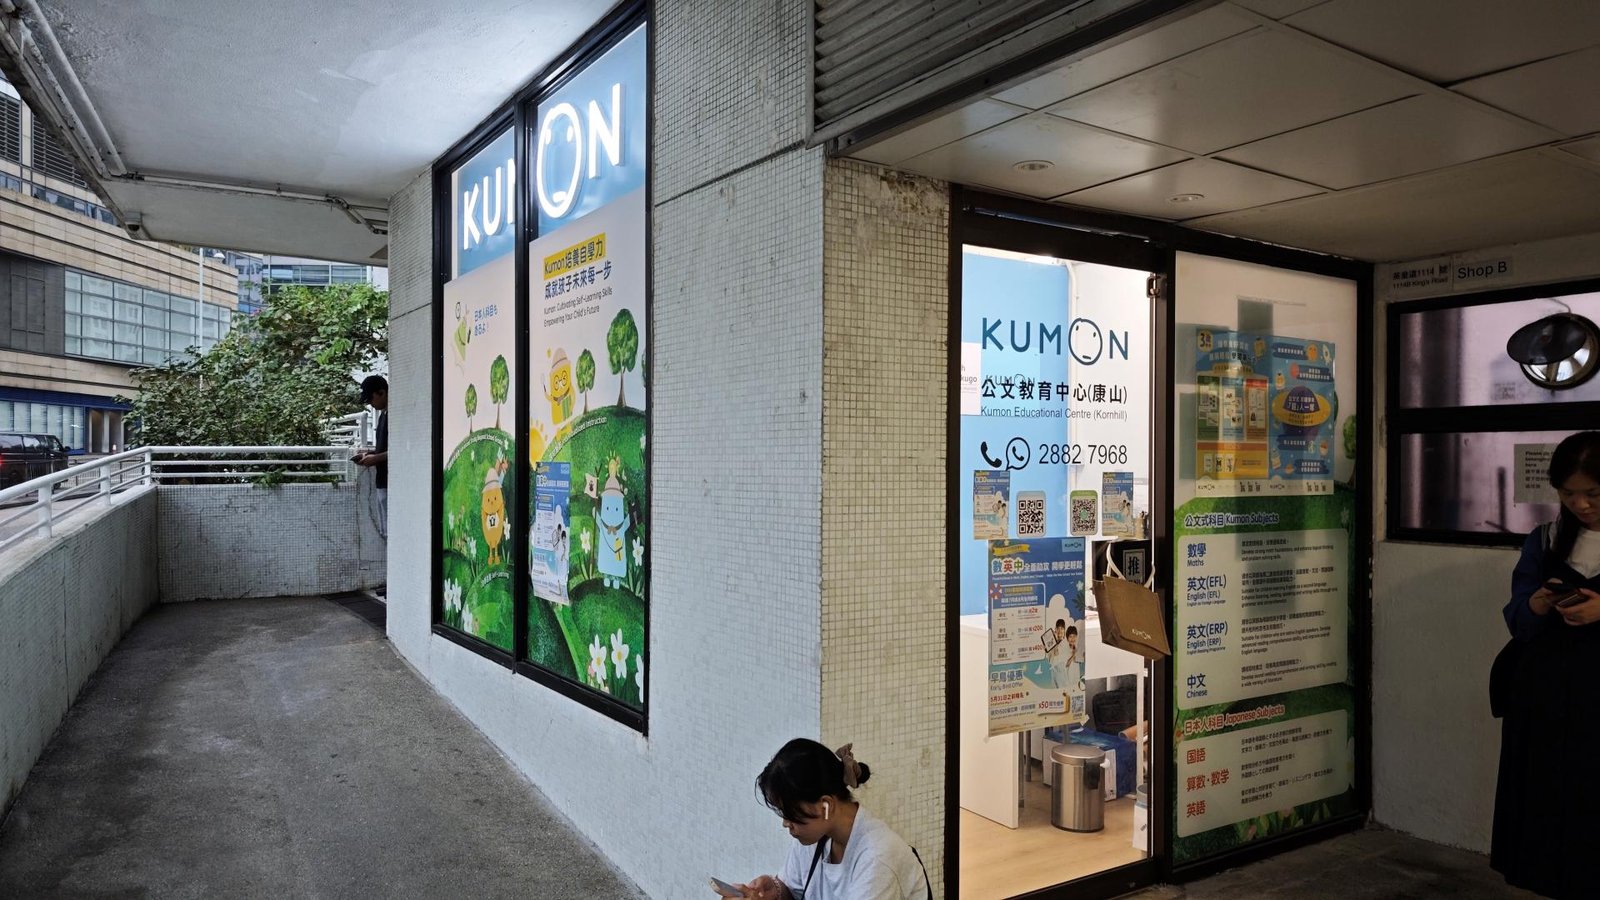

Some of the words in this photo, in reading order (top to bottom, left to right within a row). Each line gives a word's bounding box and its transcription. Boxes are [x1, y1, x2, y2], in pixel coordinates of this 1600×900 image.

[1458, 265, 1493, 279] Shop
[1498, 261, 1507, 273] B
[545, 261, 612, 300] 成就孩子未來每一步
[1411, 279, 1429, 287] King's
[544, 314, 565, 328] Empowering
[587, 305, 600, 316] Future
[982, 317, 1129, 366] KUMON
[981, 380, 1128, 404] 公文教育中心(康山)
[981, 406, 1011, 418] Kumon
[1015, 407, 1063, 419] Educational
[1064, 408, 1092, 420] Centre
[1093, 409, 1128, 422] (Kornhill)
[1039, 444, 1082, 465] 2882
[1087, 444, 1128, 465] 7968
[1185, 513, 1224, 527] 公文式科目
[1225, 514, 1250, 525] Kumon
[1250, 512, 1279, 525] Subjects
[1187, 543, 1207, 558] 數學
[1127, 556, 1140, 577] 推
[1187, 558, 1204, 567] Maths
[1187, 574, 1227, 592] 英文(EFL)
[1187, 591, 1206, 601] English
[1207, 589, 1221, 600] (EFL)
[1187, 622, 1228, 640] 英文(ERP)
[1187, 638, 1206, 650] English
[1207, 636, 1222, 647] (ERP)
[1187, 673, 1206, 689] 中文
[1186, 689, 1208, 699] Chinese
[1184, 715, 1224, 734] 日本人科目
[1225, 711, 1256, 725] Japanese
[1256, 705, 1285, 719] Subjects
[1186, 747, 1206, 764] 国語
[1186, 800, 1206, 818] 英語
